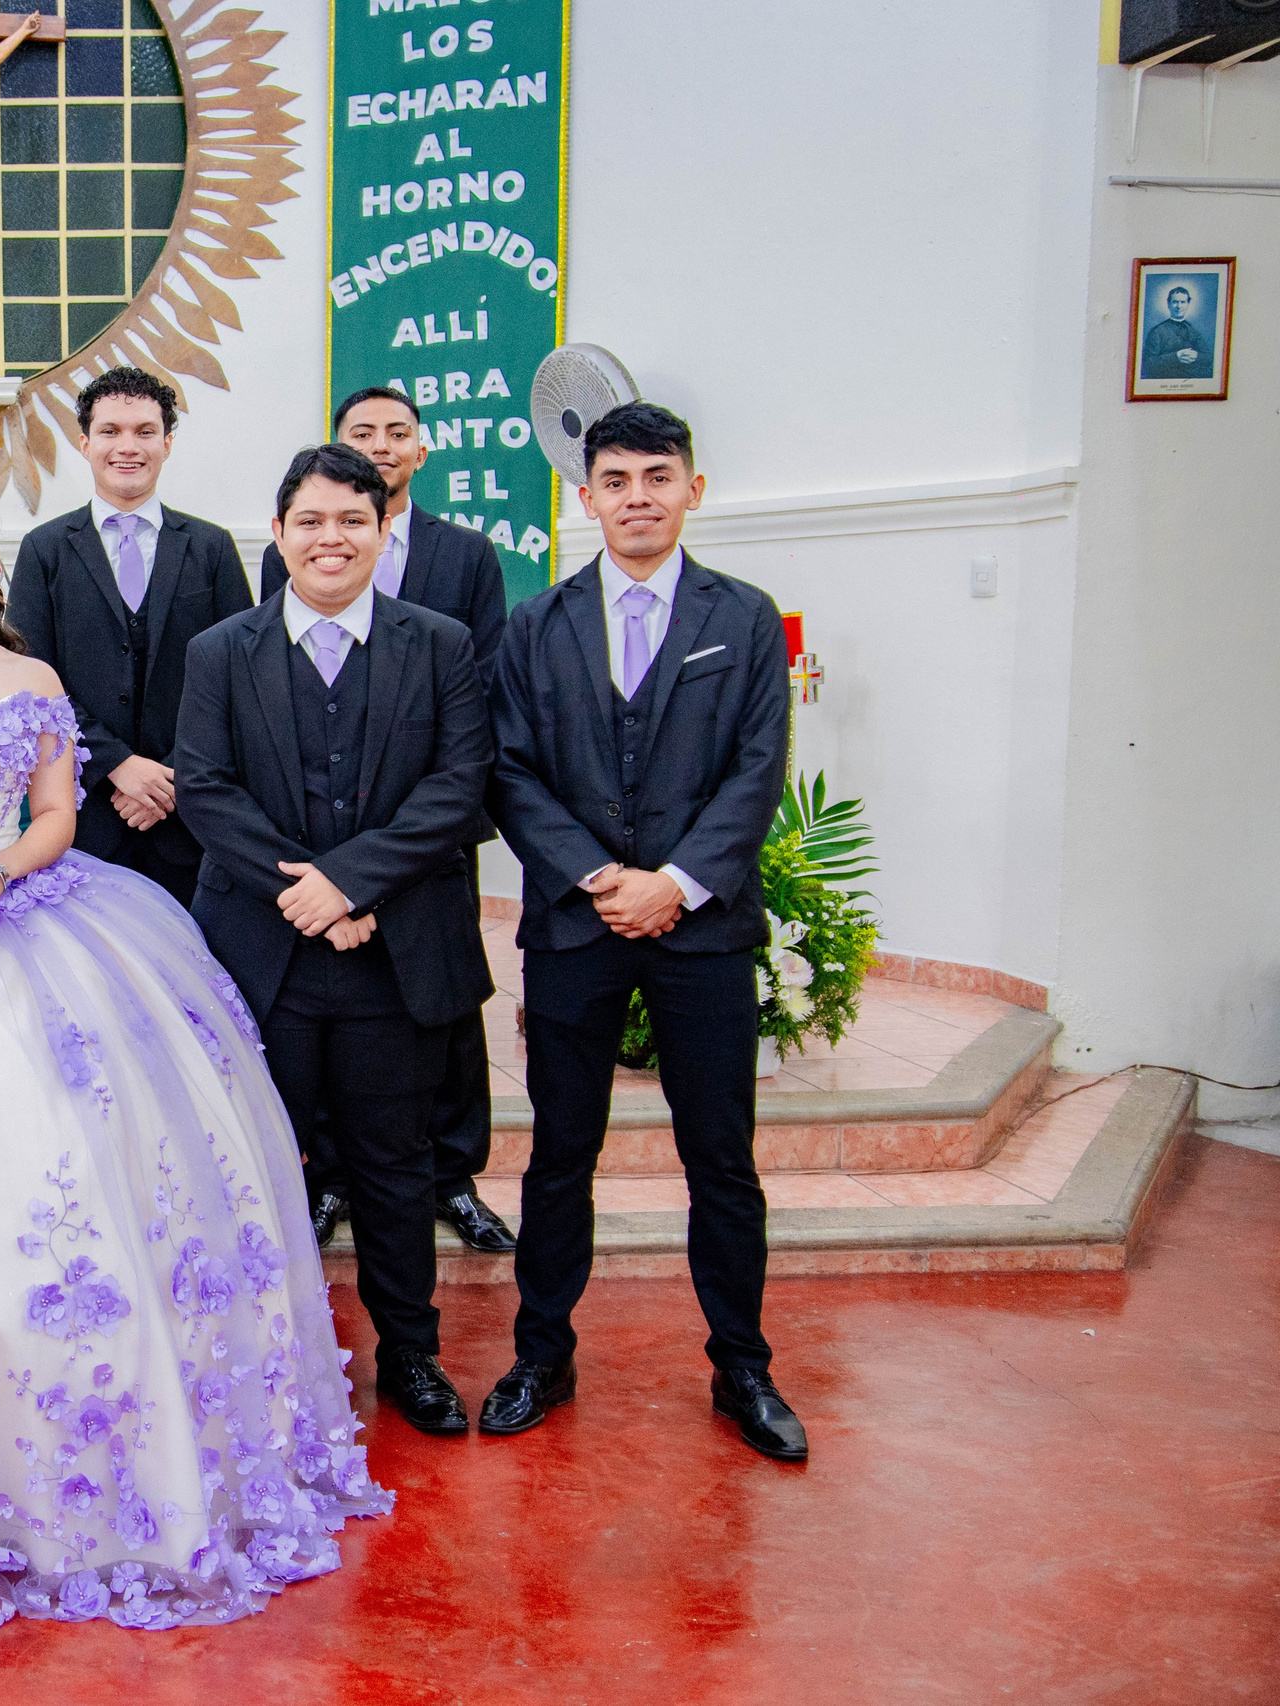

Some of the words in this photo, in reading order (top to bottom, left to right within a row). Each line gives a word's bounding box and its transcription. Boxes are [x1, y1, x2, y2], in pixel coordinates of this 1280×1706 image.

[402, 19, 494, 63] LOS
[348, 64, 547, 127] ECHARÁN
[414, 127, 472, 165] AL
[362, 170, 525, 217] HORNO
[329, 221, 558, 308] ENCENDIDO.
[392, 294, 488, 347] ALLÍ
[449, 469, 509, 502] EL
